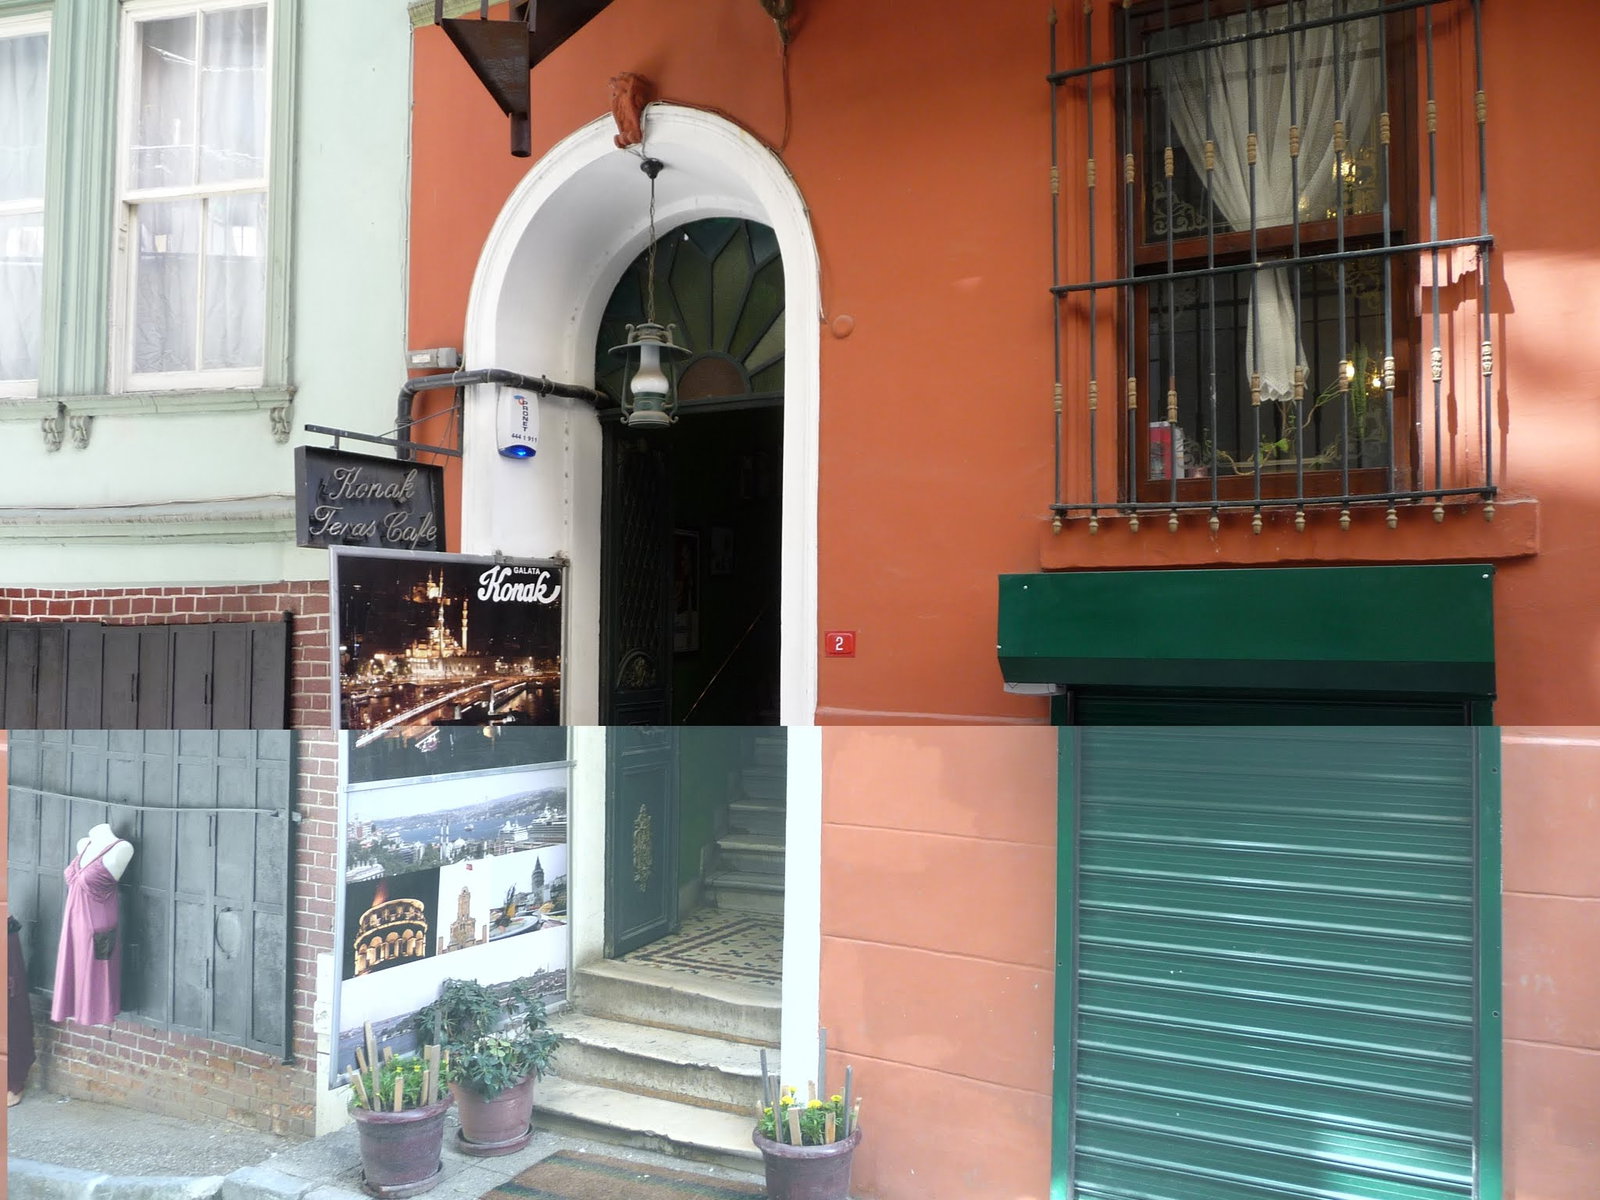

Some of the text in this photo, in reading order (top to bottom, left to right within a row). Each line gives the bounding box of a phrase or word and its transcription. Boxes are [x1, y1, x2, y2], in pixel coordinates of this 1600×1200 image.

[329, 466, 418, 500] Konak
[383, 511, 438, 550] Cafe
[477, 565, 561, 604] Konak
[513, 566, 541, 575] GALATA
[835, 636, 844, 651] 2
